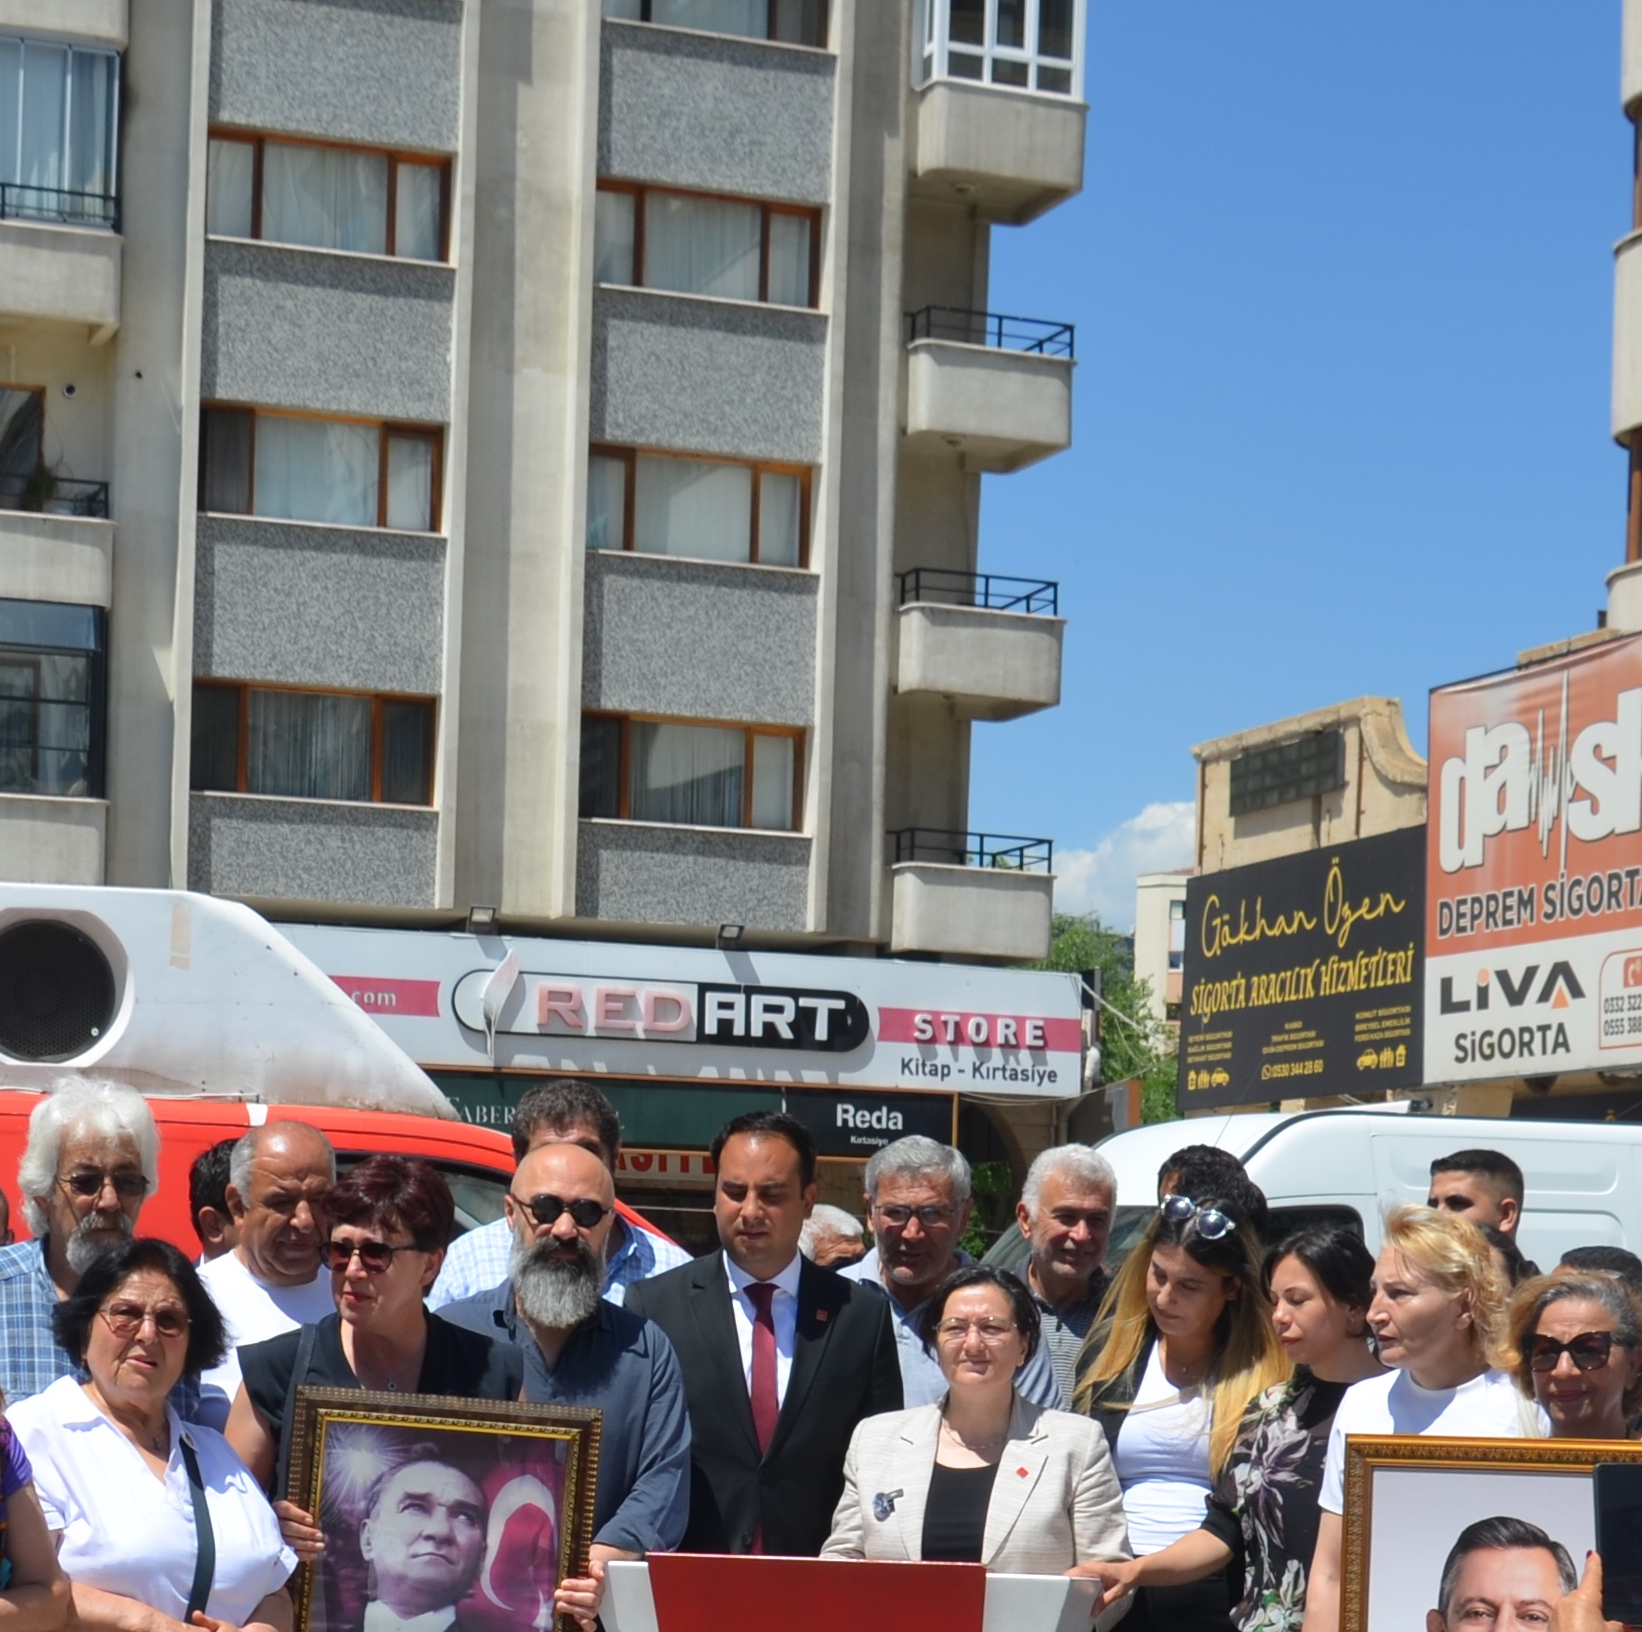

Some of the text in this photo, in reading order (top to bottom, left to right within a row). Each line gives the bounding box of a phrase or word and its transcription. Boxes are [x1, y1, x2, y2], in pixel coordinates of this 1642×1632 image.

[1201, 856, 1406, 958] Gökhan Özen
[1437, 885, 1537, 939] DEPREM
[351, 990, 398, 1007] com
[913, 1013, 1046, 1049] STORE
[901, 1057, 952, 1080] Kitap
[972, 1060, 1058, 1087] Kırtasiye
[836, 1103, 904, 1131] Reda
